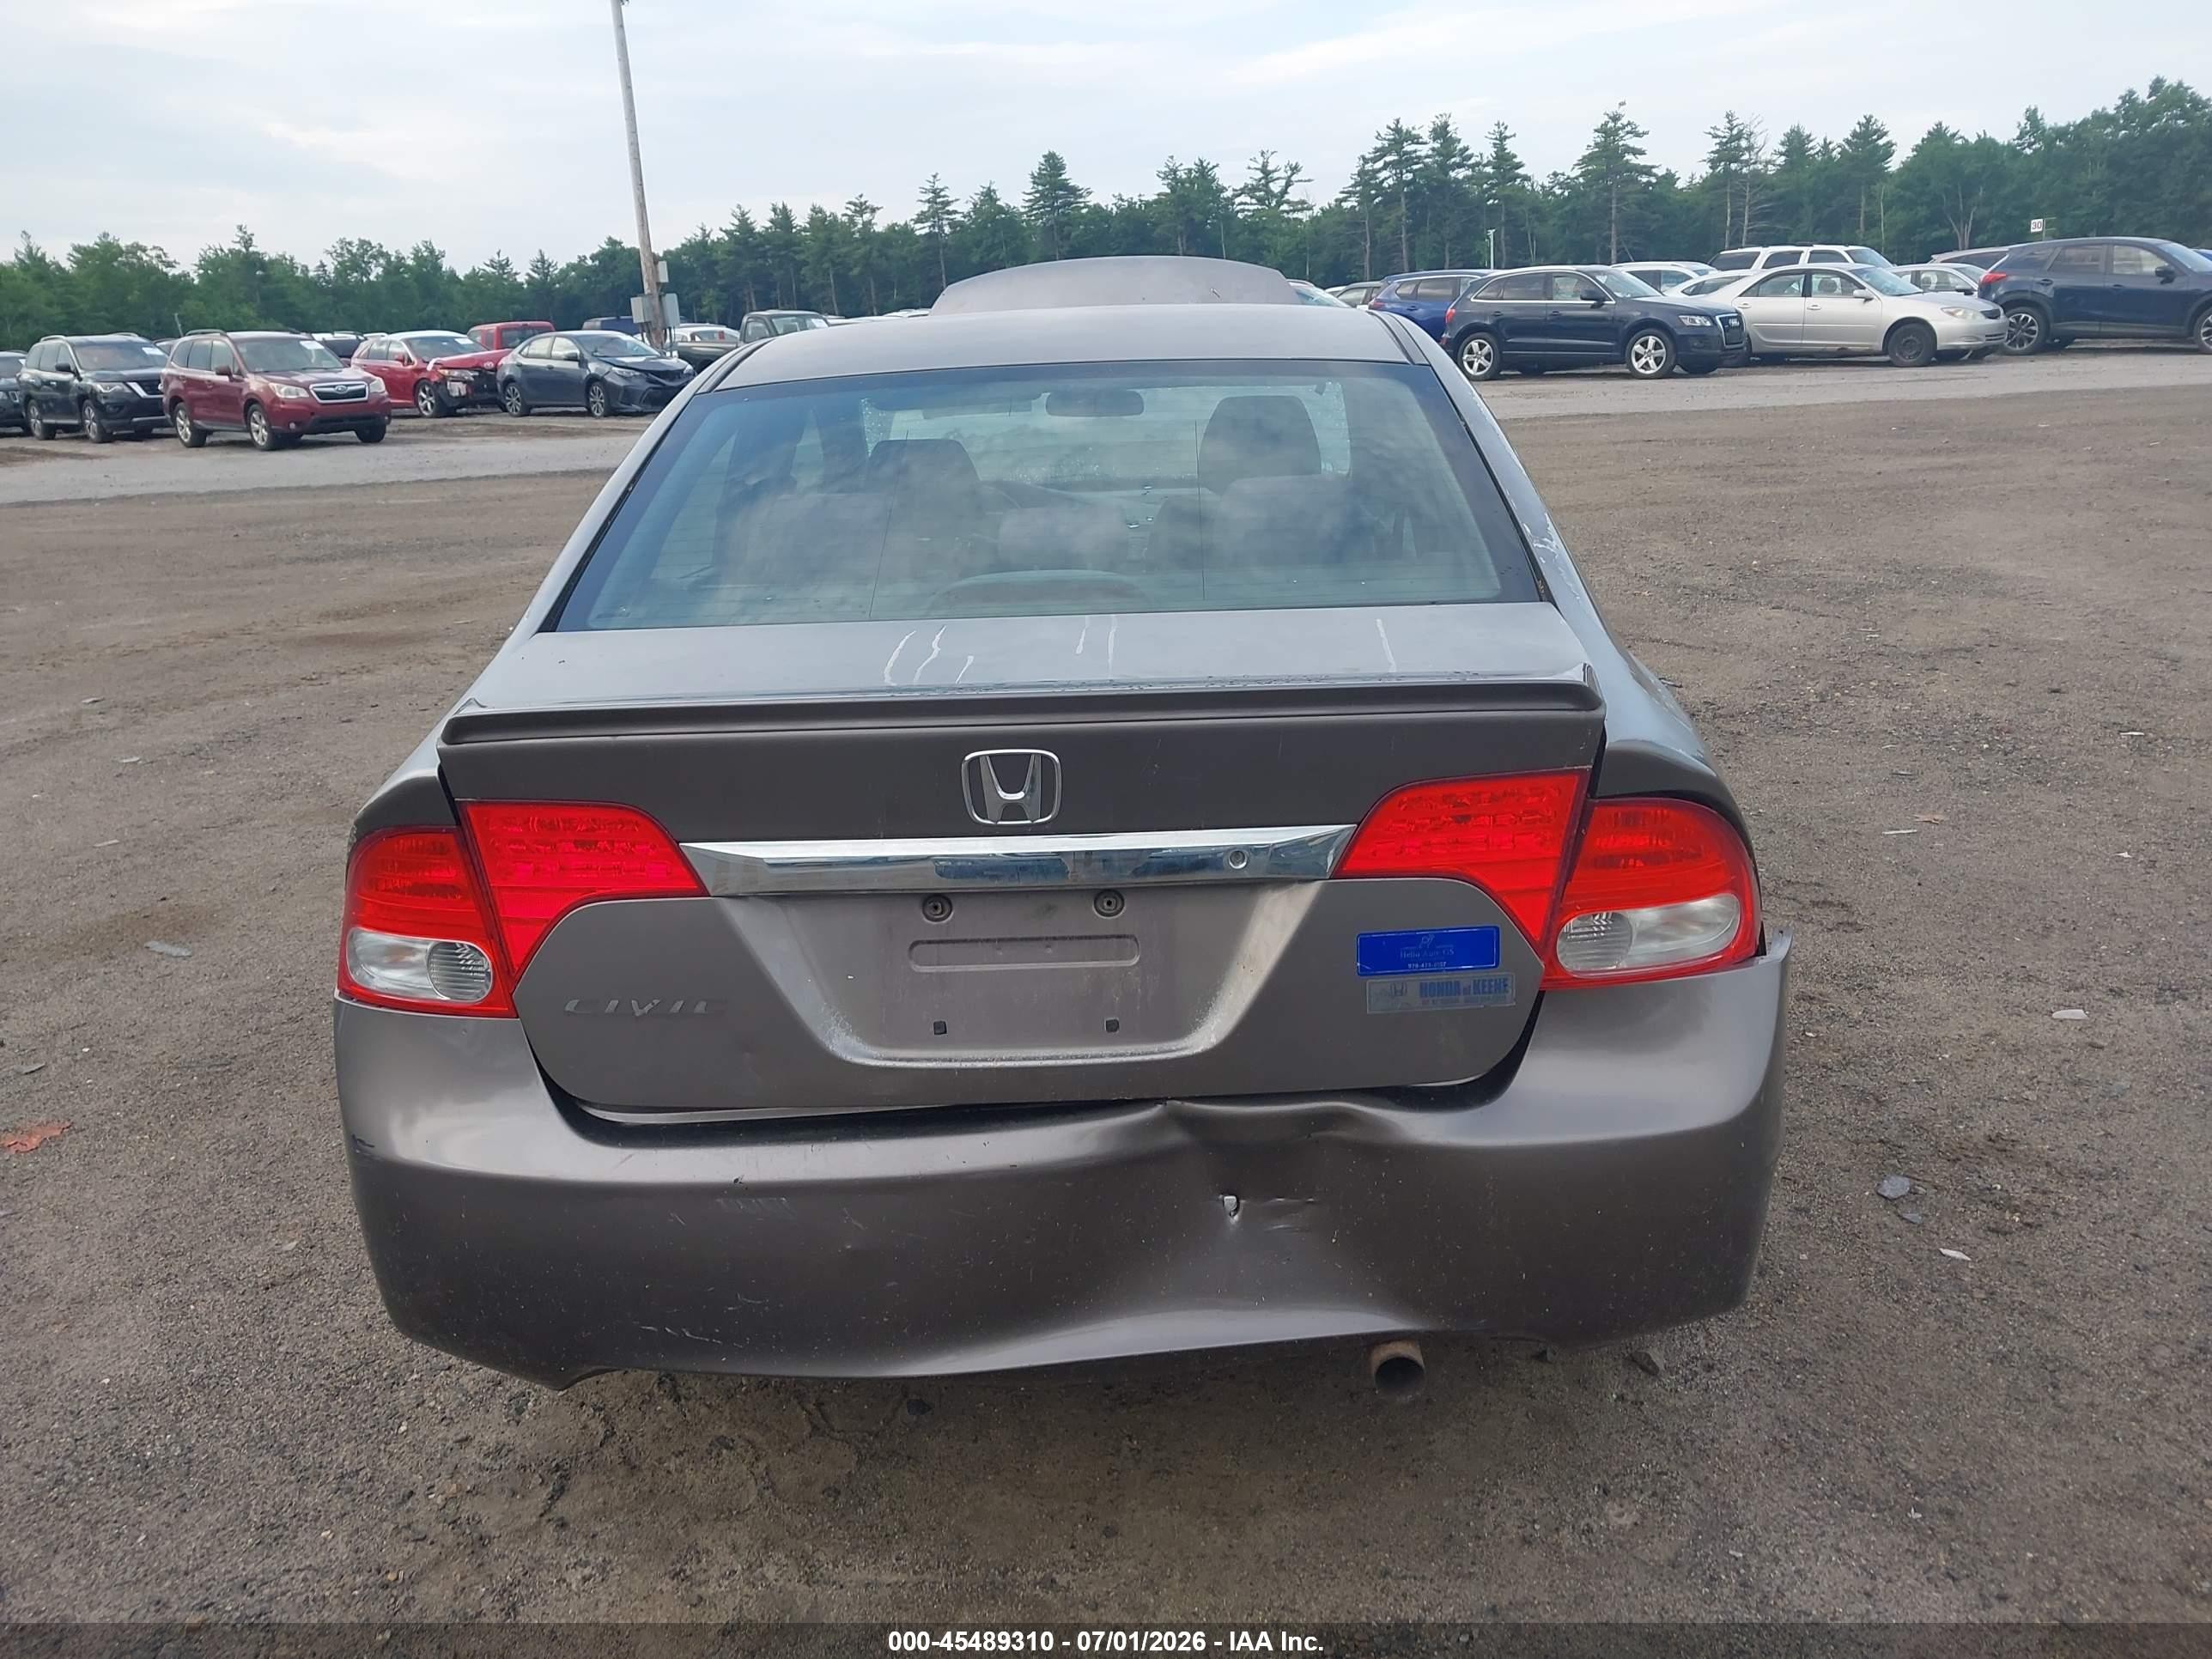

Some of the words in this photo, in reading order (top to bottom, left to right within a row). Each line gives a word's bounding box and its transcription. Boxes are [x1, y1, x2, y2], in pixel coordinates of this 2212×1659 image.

[2032, 221, 2042, 230] 30
[1419, 980, 1461, 998] HONDA
[1473, 977, 1510, 995] KEENE
[563, 999, 726, 1017] CIVIC
